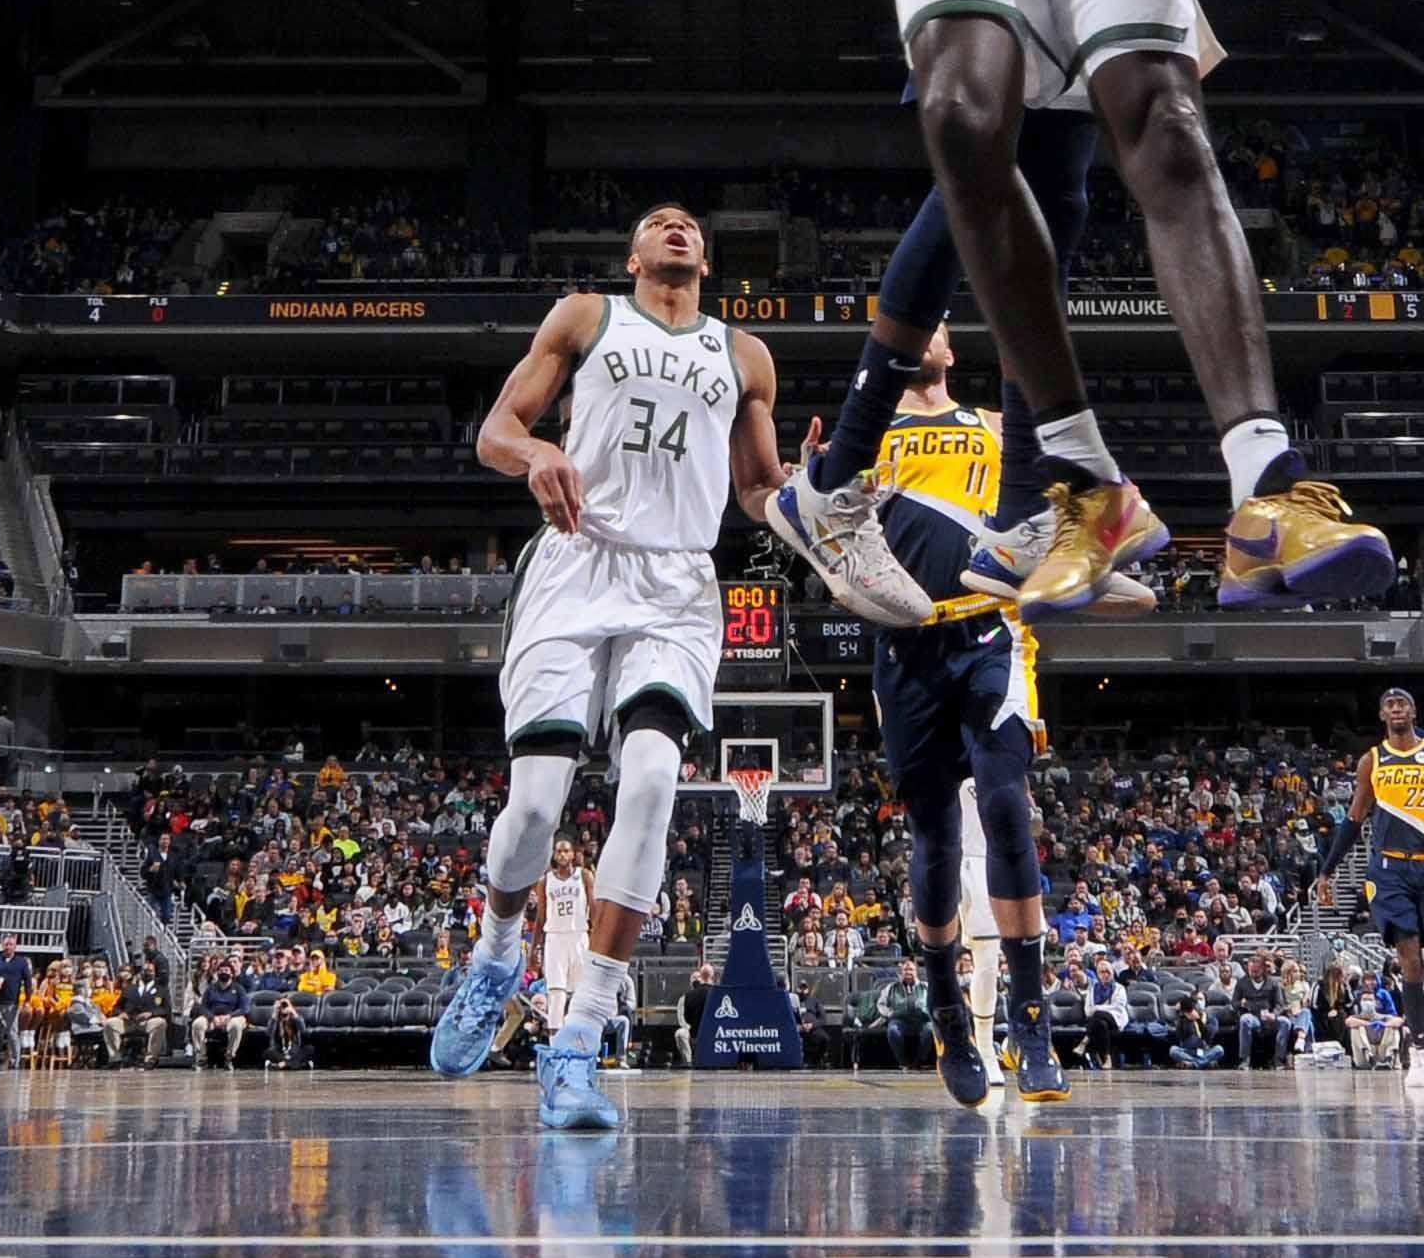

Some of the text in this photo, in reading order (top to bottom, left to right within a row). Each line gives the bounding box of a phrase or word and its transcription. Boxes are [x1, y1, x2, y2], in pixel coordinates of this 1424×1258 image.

[150, 297, 168, 306] FLS
[835, 295, 856, 306] QTR
[1338, 295, 1357, 303] FLS
[89, 308, 100, 322] 4
[270, 302, 426, 318] INDIANA PACERS
[719, 298, 788, 320] 10:01
[840, 306, 851, 320] 3
[1067, 299, 1170, 317] MILWAUKE
[1343, 305, 1353, 318] 2
[1407, 304, 1417, 318] 5
[603, 348, 729, 408] BUCKS
[623, 396, 689, 463] 34
[889, 431, 985, 462] PACERS
[965, 461, 990, 499] 11
[728, 587, 776, 607] 10:01
[728, 608, 771, 642] 20
[822, 623, 861, 636] BUCKS
[735, 648, 782, 659] TISSOT
[838, 642, 858, 655] 54
[557, 900, 574, 917] 22
[714, 1026, 779, 1039] Ascension
[714, 1040, 782, 1054] St. Vincent
